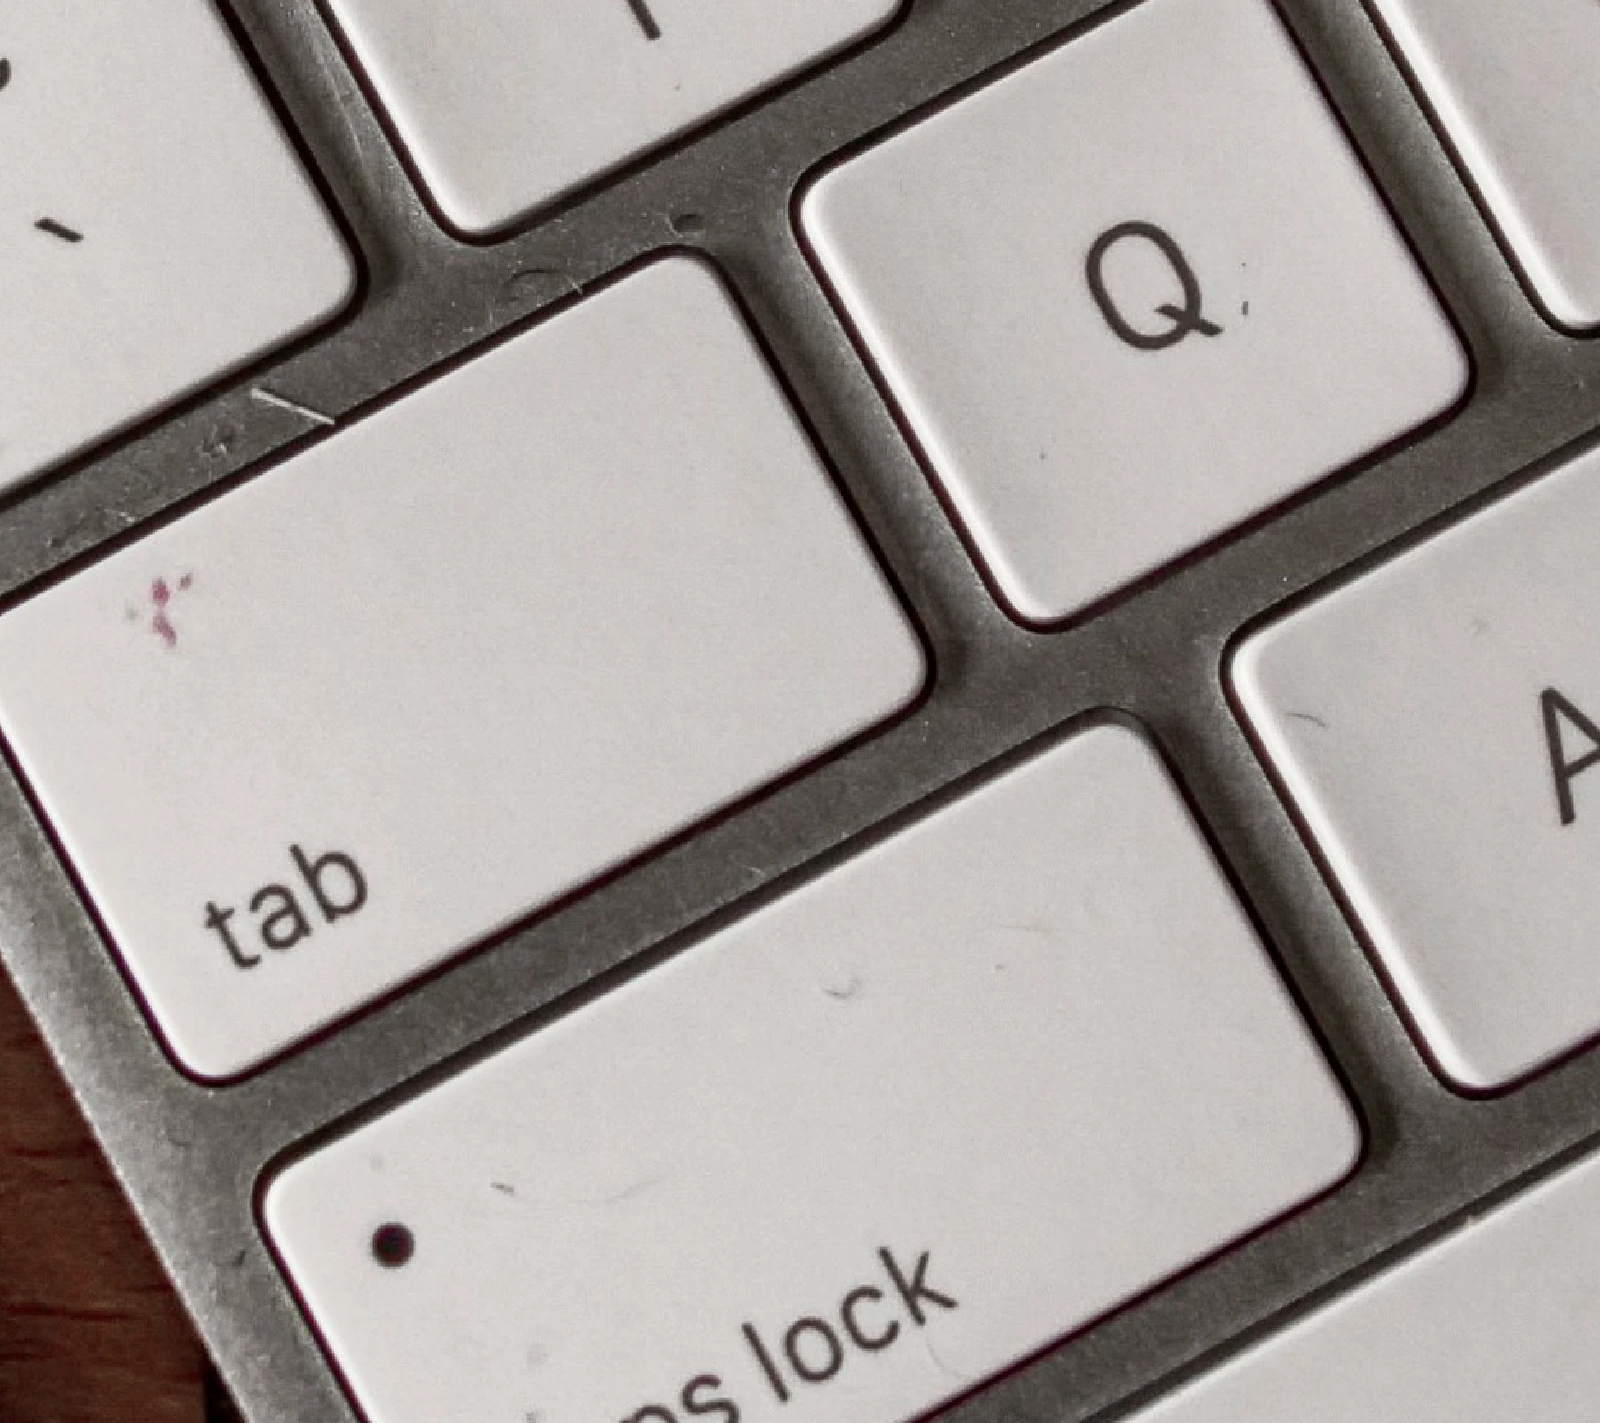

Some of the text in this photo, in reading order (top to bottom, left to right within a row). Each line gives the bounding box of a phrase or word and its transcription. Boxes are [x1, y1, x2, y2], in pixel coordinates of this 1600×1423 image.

[1085, 220, 1223, 350] Q
[206, 844, 367, 969] tab
[742, 1247, 959, 1405] lock
